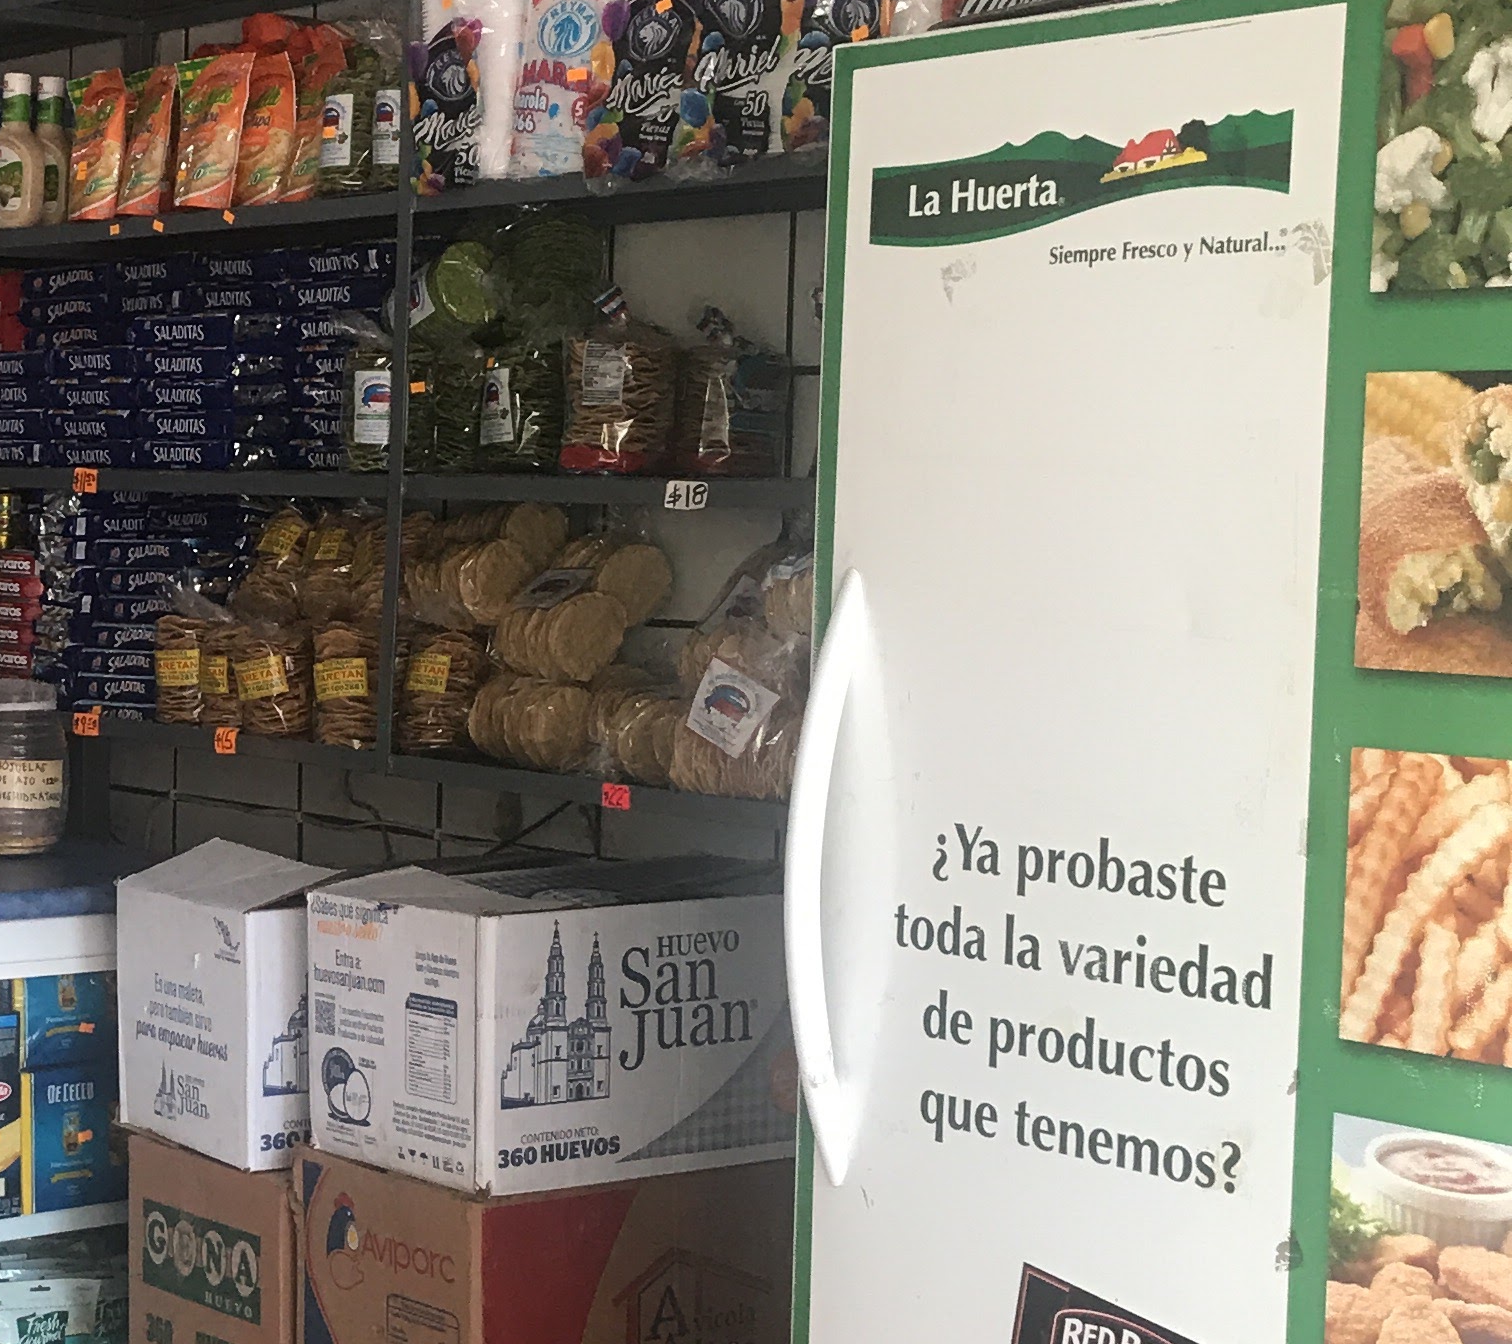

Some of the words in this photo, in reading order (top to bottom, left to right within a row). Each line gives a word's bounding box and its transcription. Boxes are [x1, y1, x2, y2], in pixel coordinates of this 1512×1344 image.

[742, 91, 768, 116] 50
[908, 185, 940, 218] La
[951, 173, 1058, 215] Huerta
[1049, 238, 1117, 268] Siempre
[1122, 237, 1178, 261] Fresco
[1183, 239, 1194, 262] y
[298, 285, 351, 306] SALADITAS
[154, 325, 204, 342] SALADITAS
[155, 357, 203, 374] SALADITAS
[155, 388, 202, 405] SALADITAS
[157, 418, 206, 435] SALADITAS
[153, 447, 202, 464] SALADITAS
[666, 483, 706, 508] $18
[126, 544, 169, 565] SALADITAS
[108, 656, 151, 672] SALADITAS
[104, 682, 145, 699] SALADITAS
[932, 822, 1000, 882] ¿Ya
[1017, 836, 1227, 908] probaste
[894, 903, 987, 962] toda
[1004, 913, 1042, 971] la
[1058, 935, 1274, 1010] variedad
[620, 946, 719, 1010] San
[620, 1000, 753, 1072] Juan
[923, 989, 973, 1045] de
[988, 1016, 1230, 1098] productos
[177, 1075, 200, 1101] San
[178, 1096, 208, 1119] Juan
[521, 1129, 573, 1145] CONTENIDO
[920, 1087, 998, 1143] que
[1014, 1100, 1242, 1194] tenemos?
[498, 1146, 538, 1168] 360
[541, 1136, 621, 1163] HUEVOS
[27, 1313, 62, 1336] Fresh
